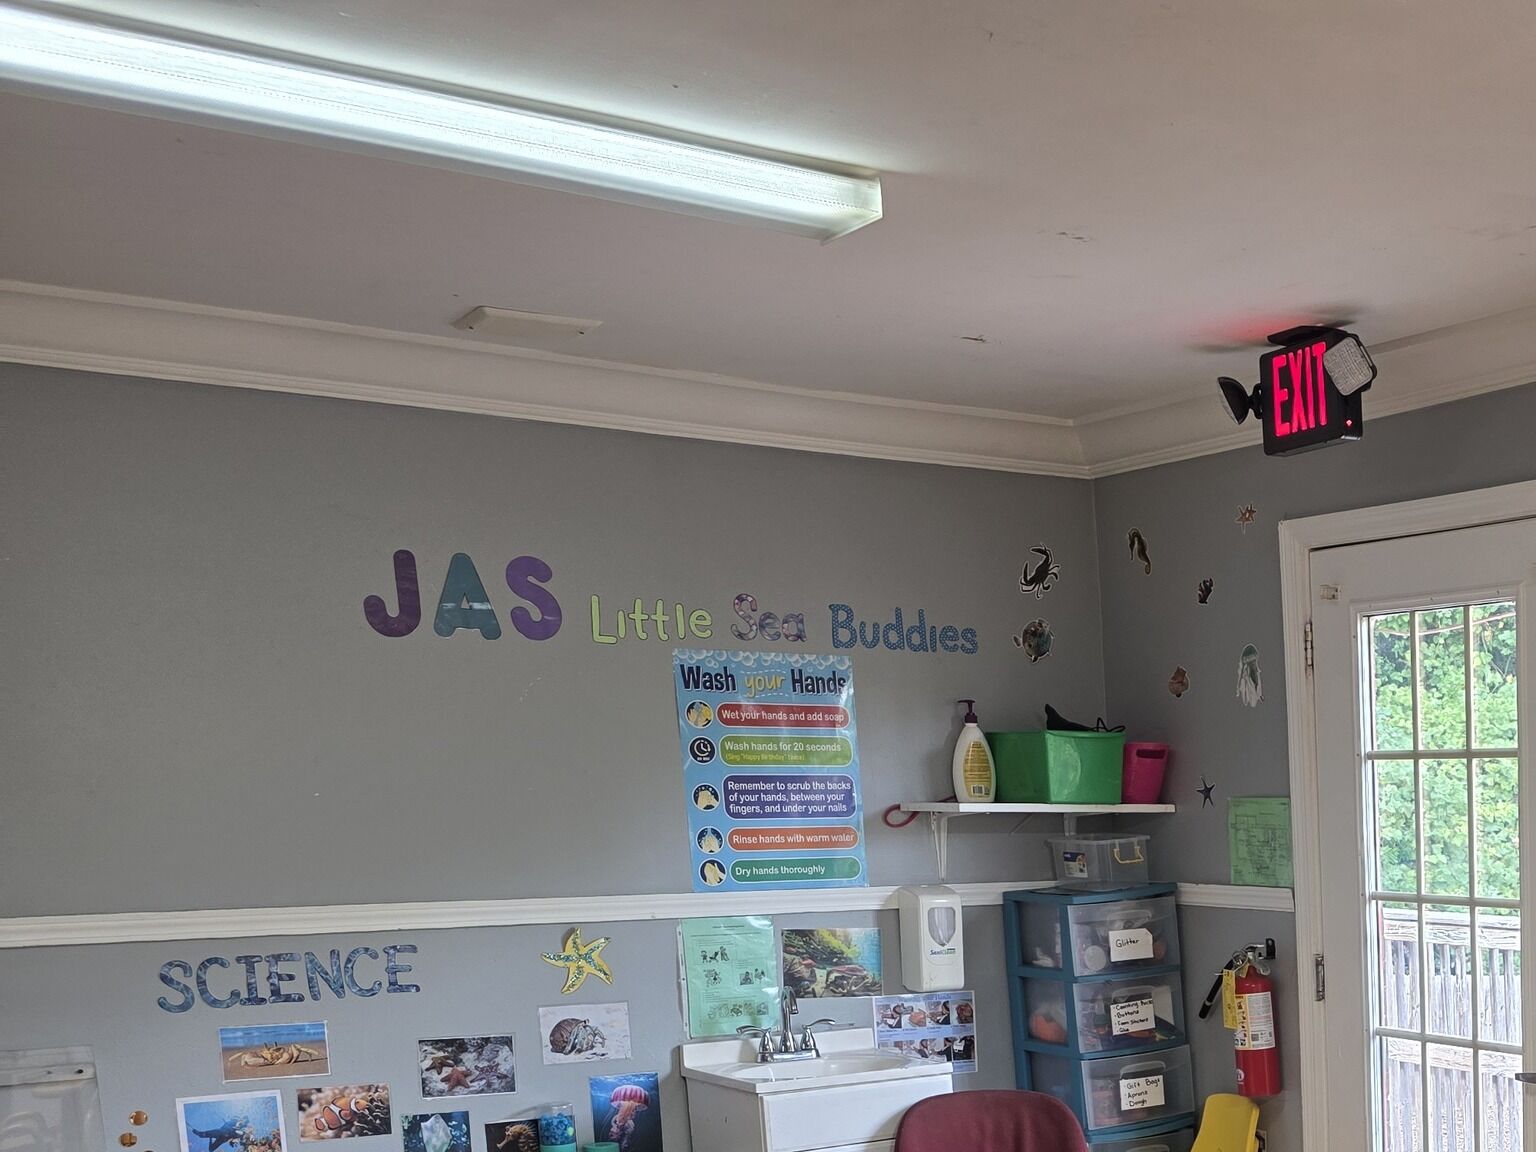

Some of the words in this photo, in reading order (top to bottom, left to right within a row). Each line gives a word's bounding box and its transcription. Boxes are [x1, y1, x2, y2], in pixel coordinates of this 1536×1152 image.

[1272, 341, 1327, 437] EXIT
[363, 549, 563, 642] JAS
[591, 593, 714, 645] Little
[730, 593, 808, 643] Sea
[828, 603, 980, 655] Buddies
[680, 664, 737, 692] Wash
[743, 674, 786, 698] your
[791, 669, 847, 697] Hands
[722, 709, 739, 720] Wet
[741, 711, 760, 723] your
[762, 710, 788, 720] hands
[789, 711, 805, 721] and
[807, 711, 822, 721] add
[824, 712, 844, 724] soap
[725, 741, 749, 751] Wash
[751, 742, 778, 751] hands
[779, 742, 791, 751] for
[794, 742, 804, 751] 20
[806, 742, 841, 752] seconds
[728, 781, 775, 790] Remember
[776, 781, 785, 790] to
[787, 781, 811, 790] scrub
[813, 781, 826, 790] the
[827, 781, 851, 790] backs
[729, 792, 738, 801] of
[738, 794, 759, 804] your
[761, 792, 789, 802] hands,
[791, 792, 825, 802] between
[827, 794, 845, 803] your
[730, 804, 763, 815] fingers,
[764, 804, 781, 813] and
[782, 803, 805, 813] under
[808, 804, 826, 814] your
[828, 803, 847, 812] nails
[733, 835, 758, 844] Rinse
[759, 834, 785, 844] hands
[786, 834, 804, 843] with
[805, 835, 829, 843] warm
[831, 834, 854, 843] water
[736, 867, 751, 877] Dry
[753, 866, 779, 875] hands
[780, 864, 825, 875] thoroughly
[1116, 938, 1140, 948] Glitter
[158, 944, 421, 1013] SCIENCE
[1127, 1090, 1148, 1099] Aprons
